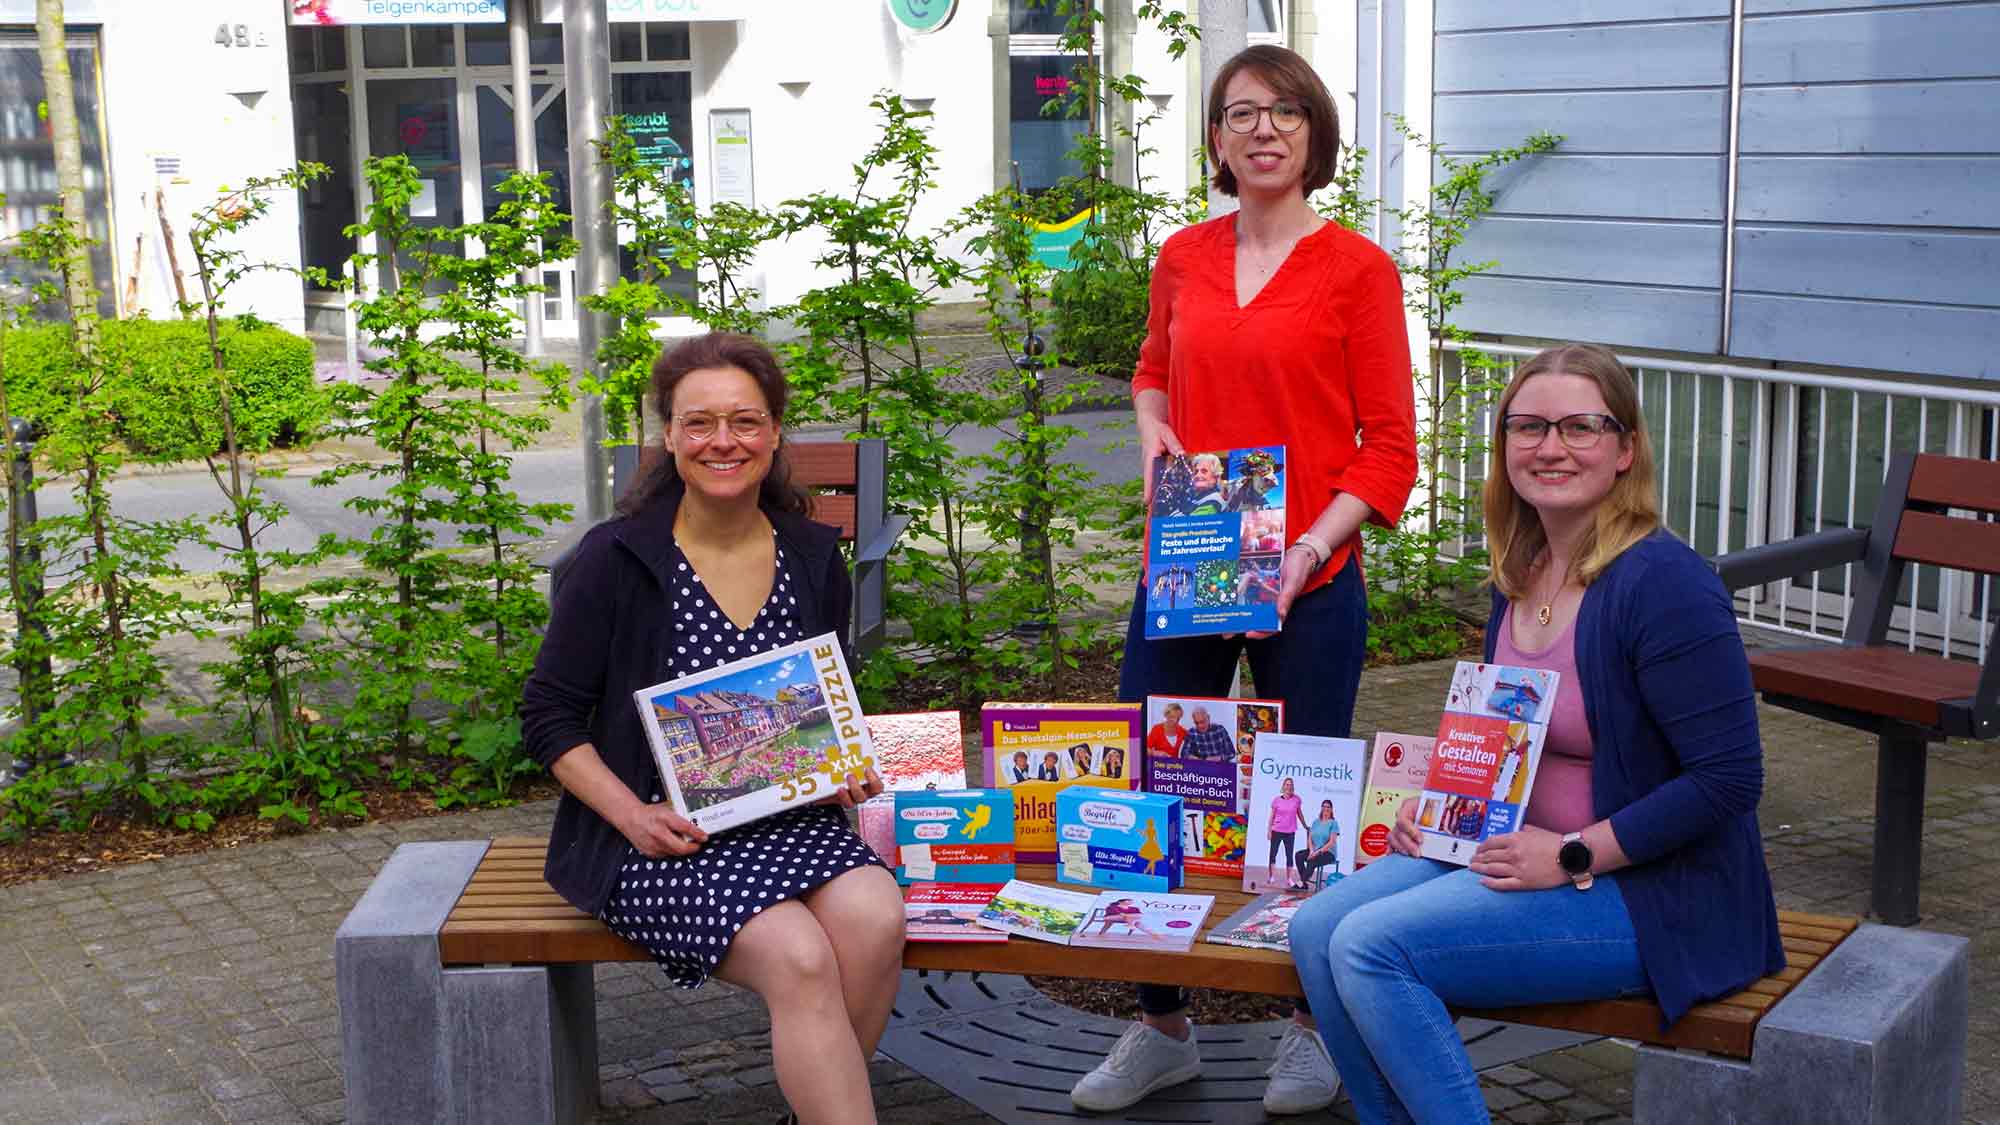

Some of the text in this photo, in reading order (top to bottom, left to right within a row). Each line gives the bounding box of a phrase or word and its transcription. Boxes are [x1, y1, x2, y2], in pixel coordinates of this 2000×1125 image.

[1172, 544, 1226, 555] Jahresverlauf
[1184, 538, 1200, 546] und
[1201, 536, 1233, 545] Bräuche
[815, 644, 859, 739] PUZZLE
[1439, 741, 1497, 766] Gestalten
[831, 753, 863, 773] XXL
[1260, 758, 1353, 780] Gymnastik
[1457, 763, 1488, 776] Senioren
[775, 767, 817, 801] 35
[1154, 770, 1232, 787] Beschäftigungs-
[1154, 784, 1233, 798] und Ideen-Buch
[1014, 796, 1056, 823] chlag
[1142, 900, 1201, 911] Yoga
